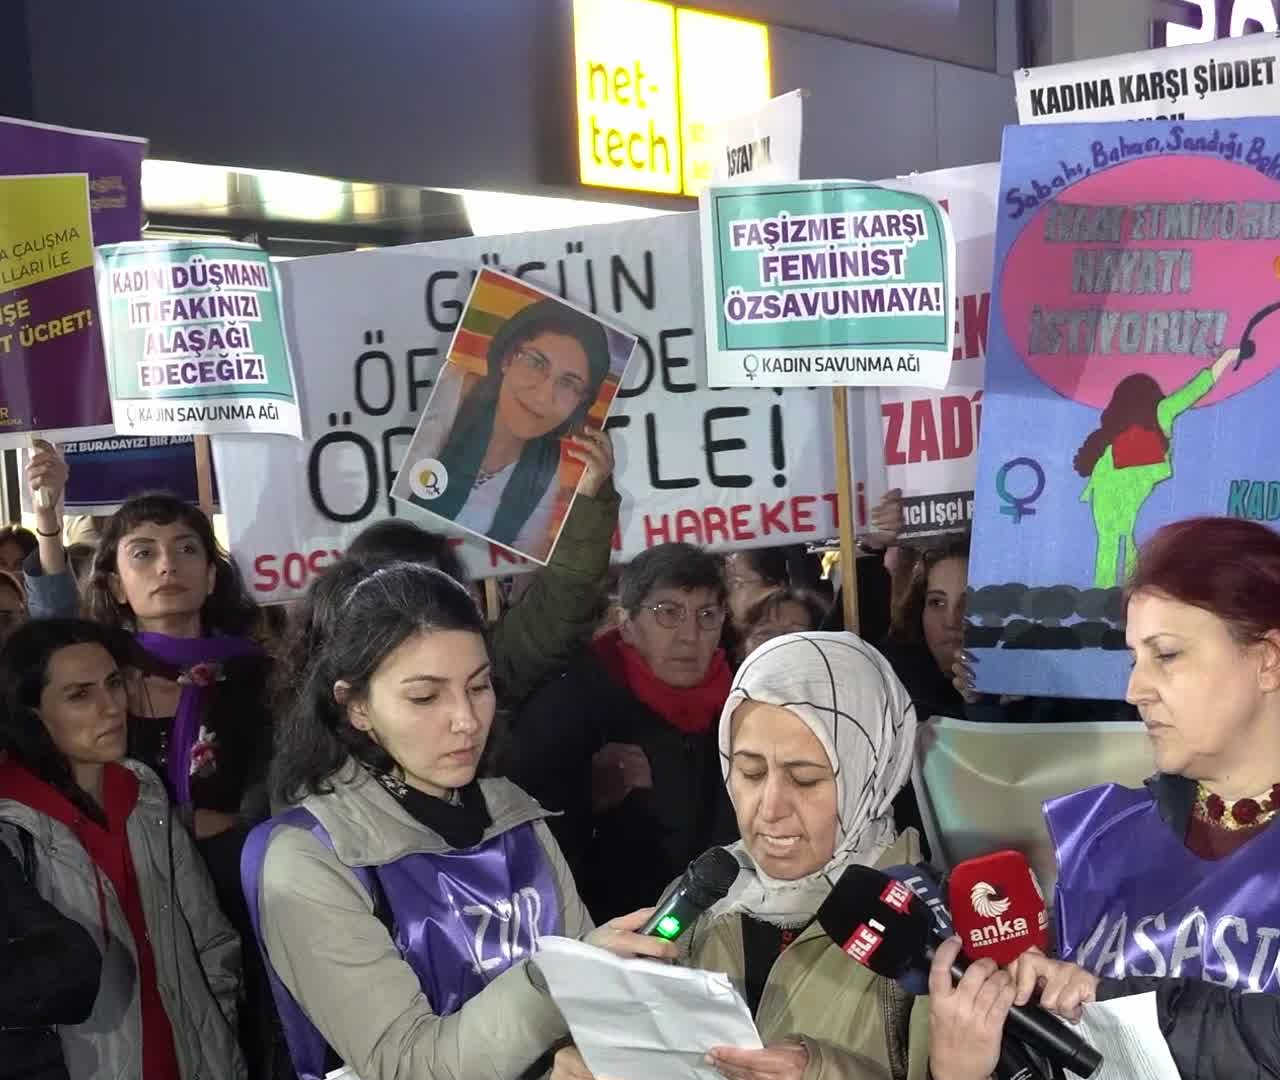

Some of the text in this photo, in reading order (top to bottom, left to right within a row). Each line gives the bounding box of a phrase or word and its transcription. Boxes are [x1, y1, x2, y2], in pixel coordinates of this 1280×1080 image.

[586, 60, 659, 109] net-
[1030, 57, 1277, 117] KADINA KARŞI ŞİDDET
[589, 114, 671, 175] tech
[12, 228, 81, 258] ÇALIŞMA
[732, 213, 926, 252] FAŞİZME KARŞI
[47, 252, 72, 275] İLE
[171, 258, 269, 291] DÜŞMANI
[761, 245, 904, 284] FEMİNİST
[726, 286, 942, 322] ÖZSAVUNMAYA!
[19, 309, 93, 348] ÜCRET!
[146, 320, 250, 357] ALAŞAĞI
[141, 352, 266, 387] EDECEĞİZ!
[762, 350, 921, 374] KADIN SAVUNMA AĞI
[177, 405, 256, 422] SAVUNMA
[258, 402, 280, 420] AĞI
[970, 916, 1028, 942] anka
